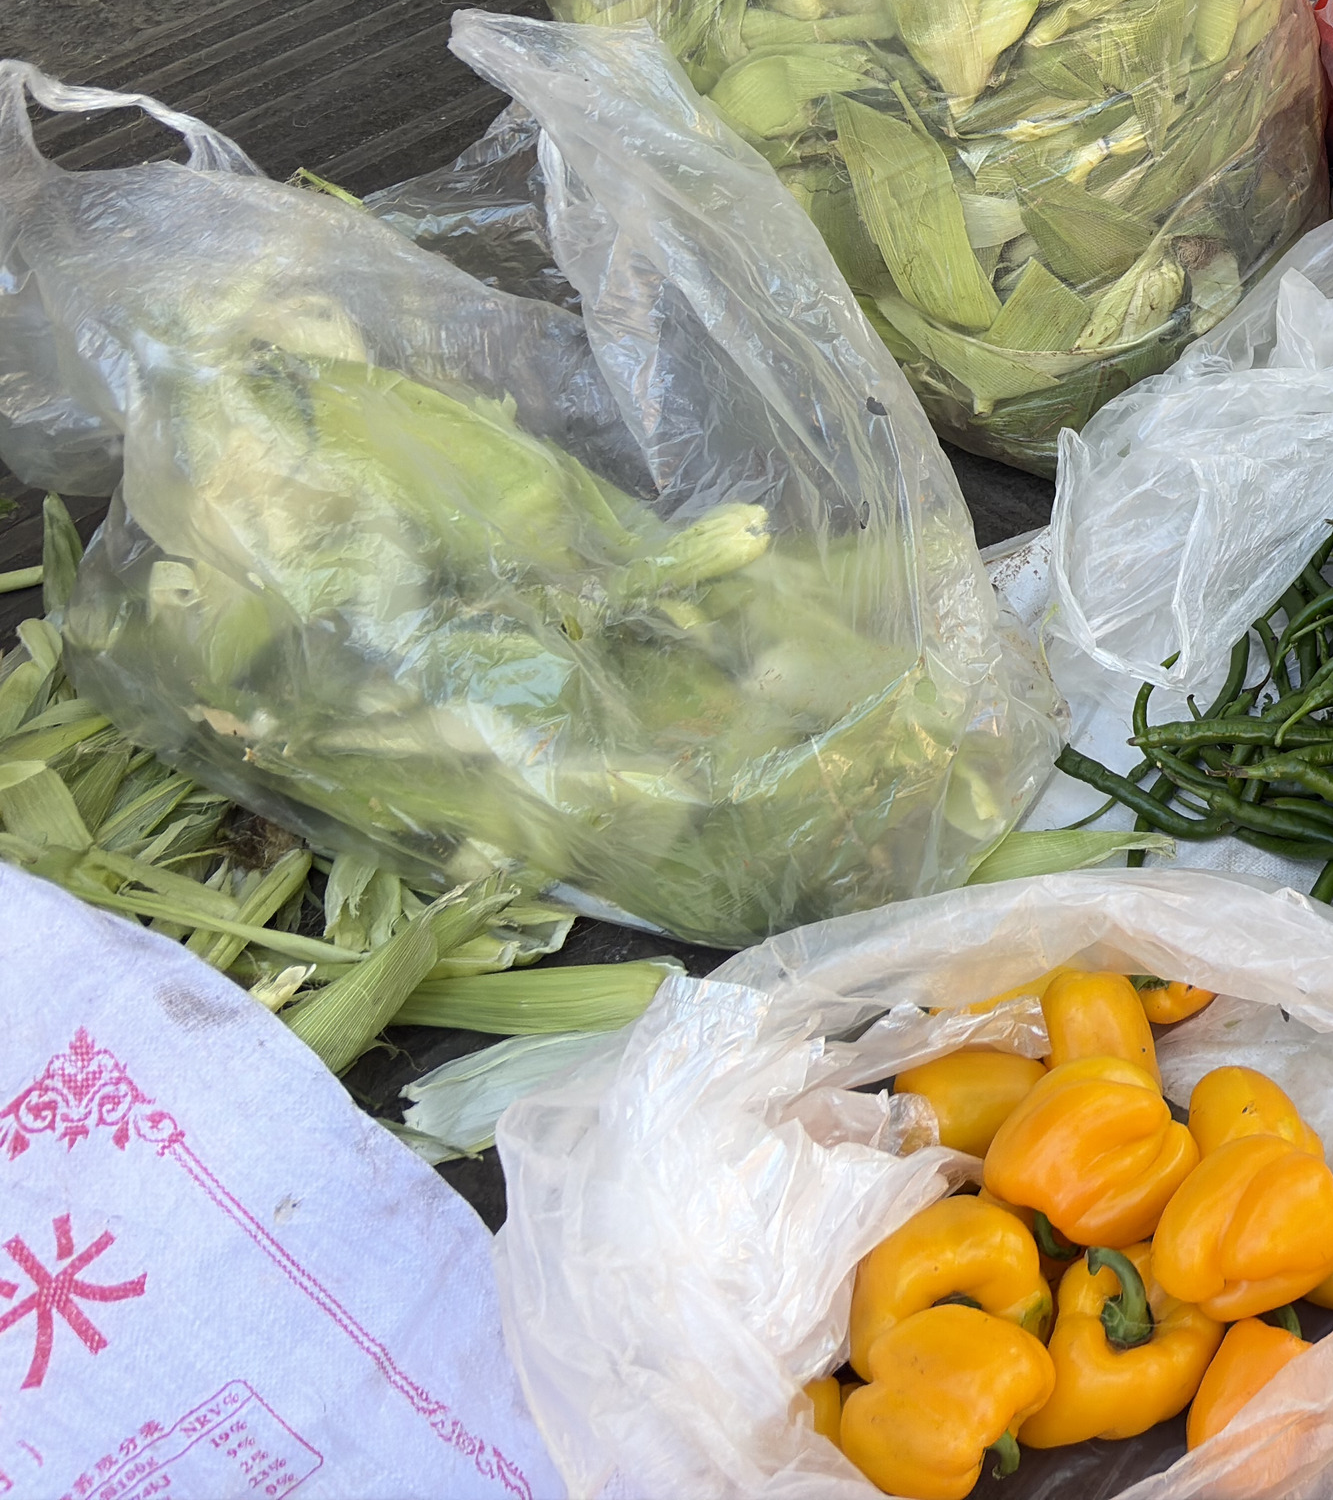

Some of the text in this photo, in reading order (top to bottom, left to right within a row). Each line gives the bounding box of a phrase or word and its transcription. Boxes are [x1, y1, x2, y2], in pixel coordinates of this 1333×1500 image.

[0, 1211, 148, 1391] 米
[60, 1419, 165, 1500] 养成分表
